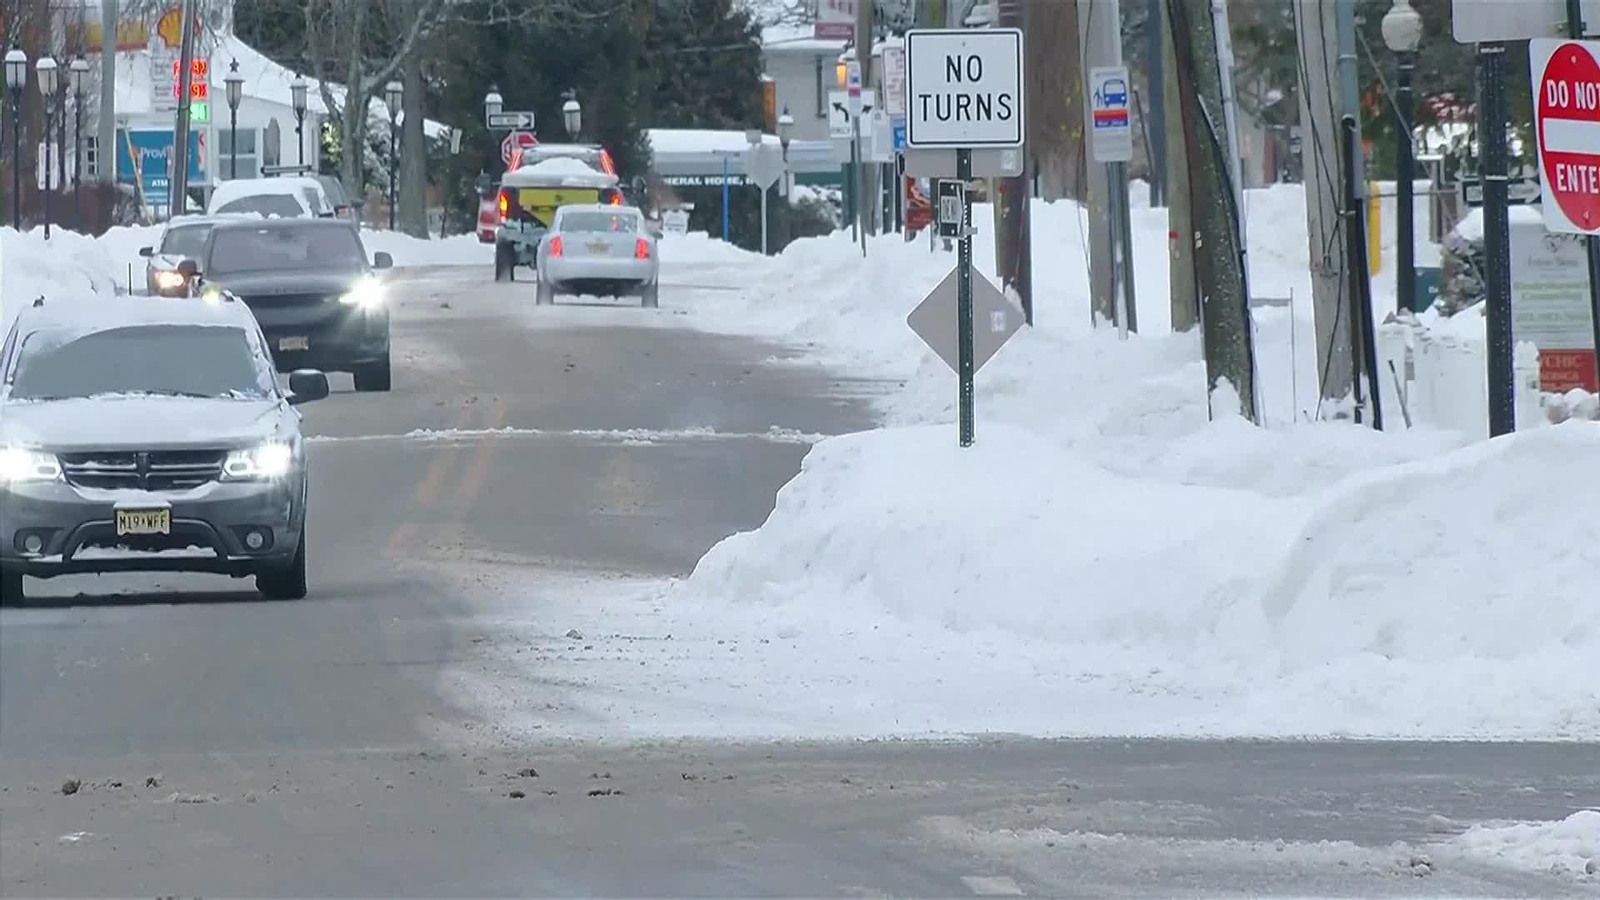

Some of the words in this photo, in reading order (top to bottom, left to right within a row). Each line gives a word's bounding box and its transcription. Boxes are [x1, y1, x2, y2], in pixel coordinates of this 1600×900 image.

[946, 55, 982, 82] NO
[919, 93, 1011, 122] TURNS
[1547, 80, 1569, 108] DO
[1556, 164, 1600, 194] ENTE
